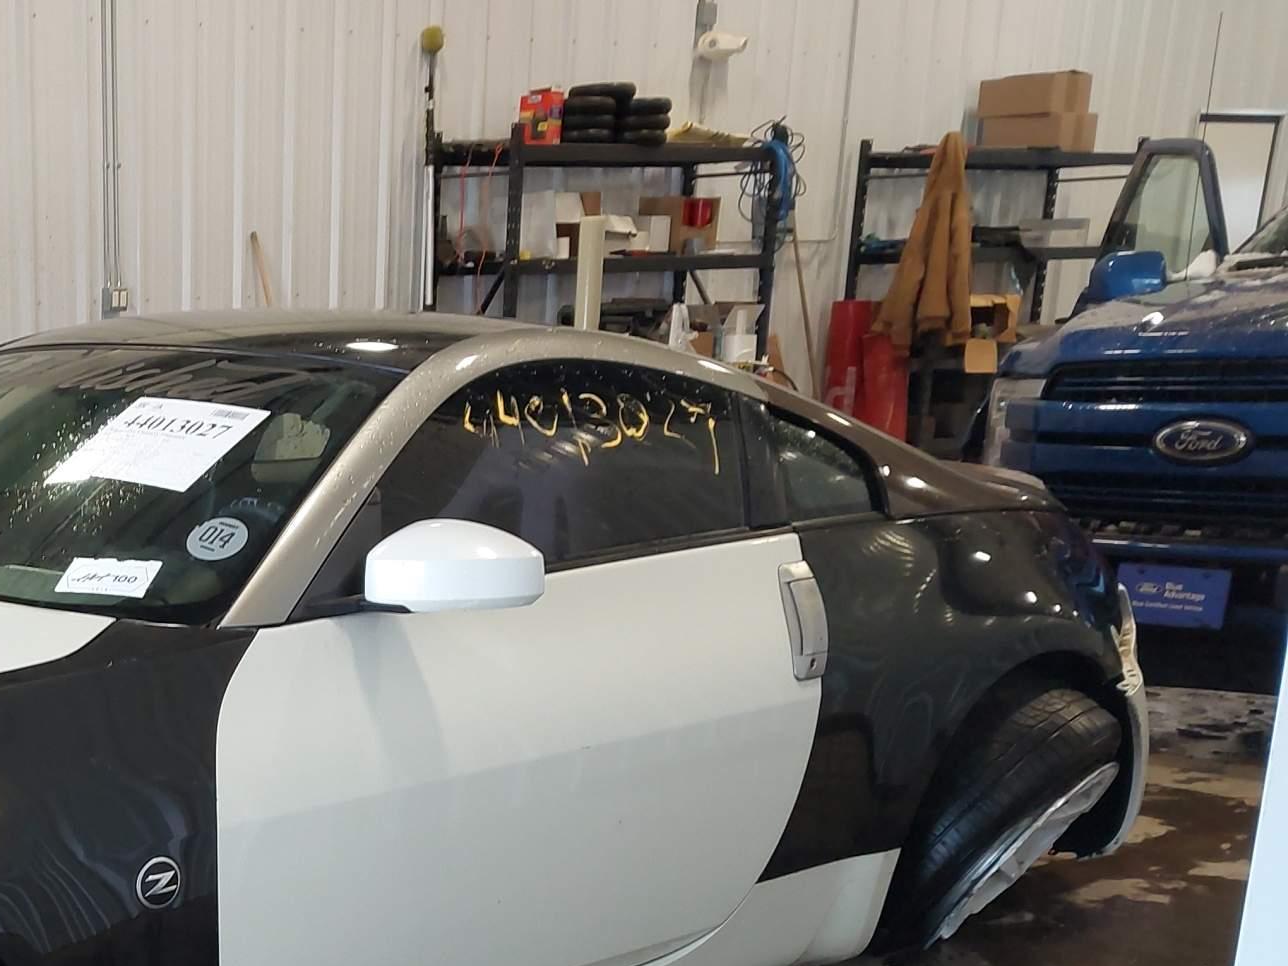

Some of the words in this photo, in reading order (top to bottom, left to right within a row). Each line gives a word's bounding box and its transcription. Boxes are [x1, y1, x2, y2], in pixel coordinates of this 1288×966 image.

[124, 414, 233, 439] 44013027
[1174, 428, 1224, 450] Ford
[198, 525, 235, 549] 014
